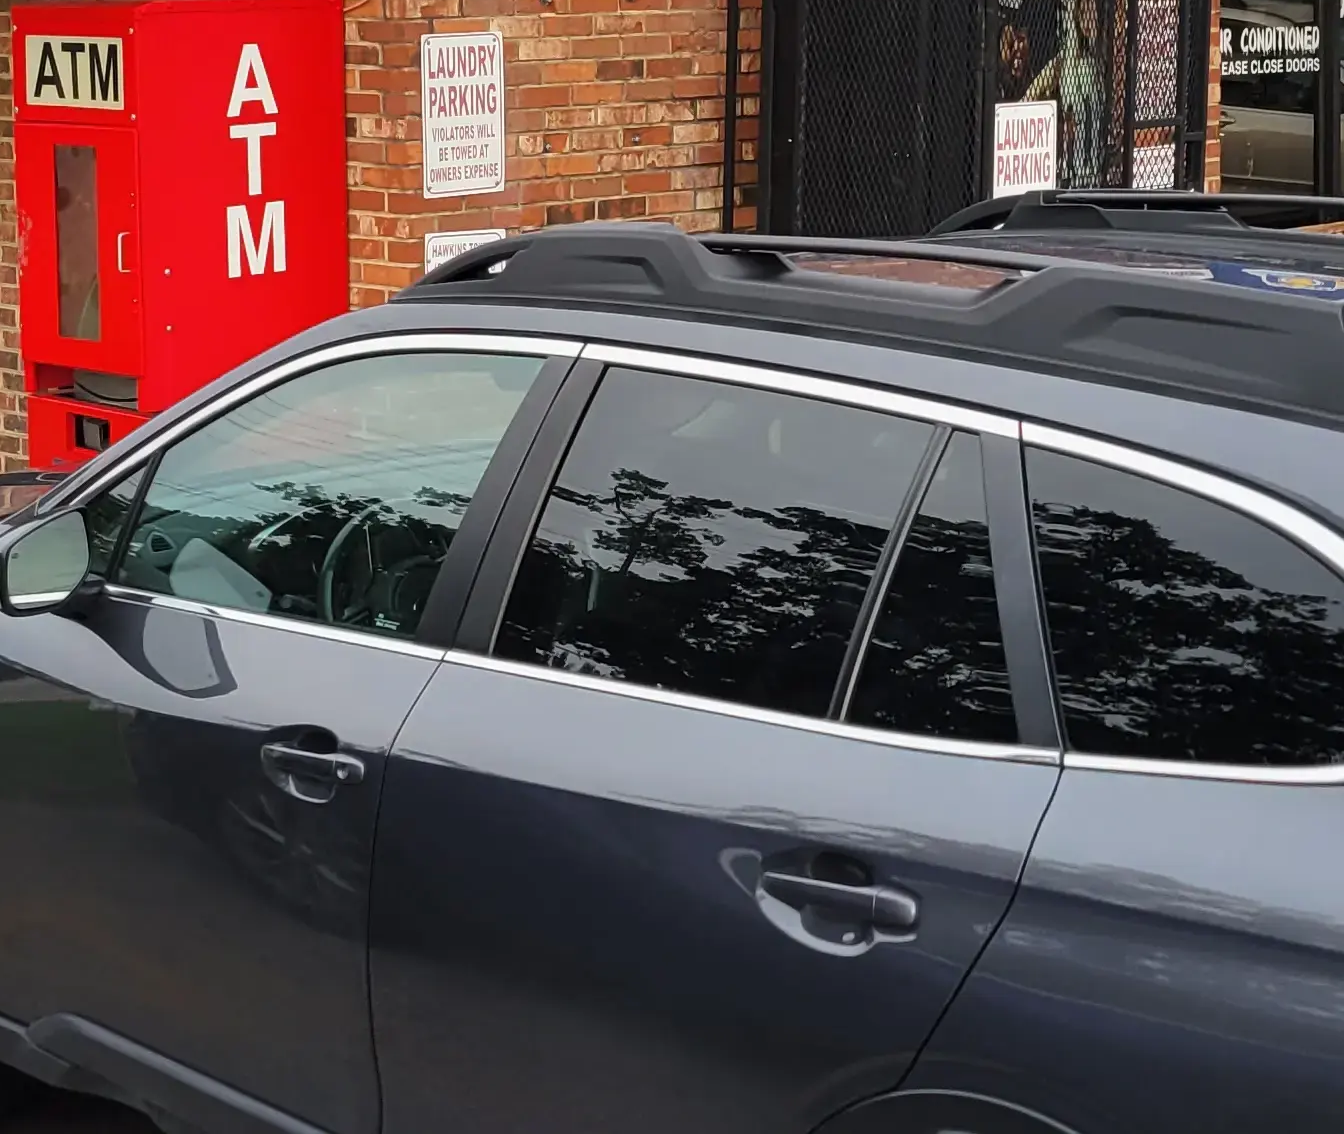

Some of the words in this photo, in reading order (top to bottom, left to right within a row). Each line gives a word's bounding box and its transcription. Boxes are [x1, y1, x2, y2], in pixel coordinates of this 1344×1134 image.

[1220, 28, 1232, 57] IR
[1240, 26, 1320, 56] CONDITIONED
[33, 41, 120, 103] ATM
[428, 44, 496, 80] LAUNDRY
[1221, 60, 1248, 75] EASE
[1251, 59, 1284, 74] CLOSE
[1285, 57, 1320, 72] DOORS
[429, 83, 497, 119] PARKING
[432, 124, 475, 142] VIOLATORS
[476, 123, 495, 139] WILL
[997, 116, 1052, 150] LAUNDRY
[226, 43, 287, 278] ATM
[439, 147, 449, 162] BE
[451, 145, 478, 161] TOWED
[479, 143, 489, 159] AT
[997, 151, 1051, 187] PARKING
[430, 166, 462, 183] OWNERS
[464, 162, 499, 180] EXPENSE
